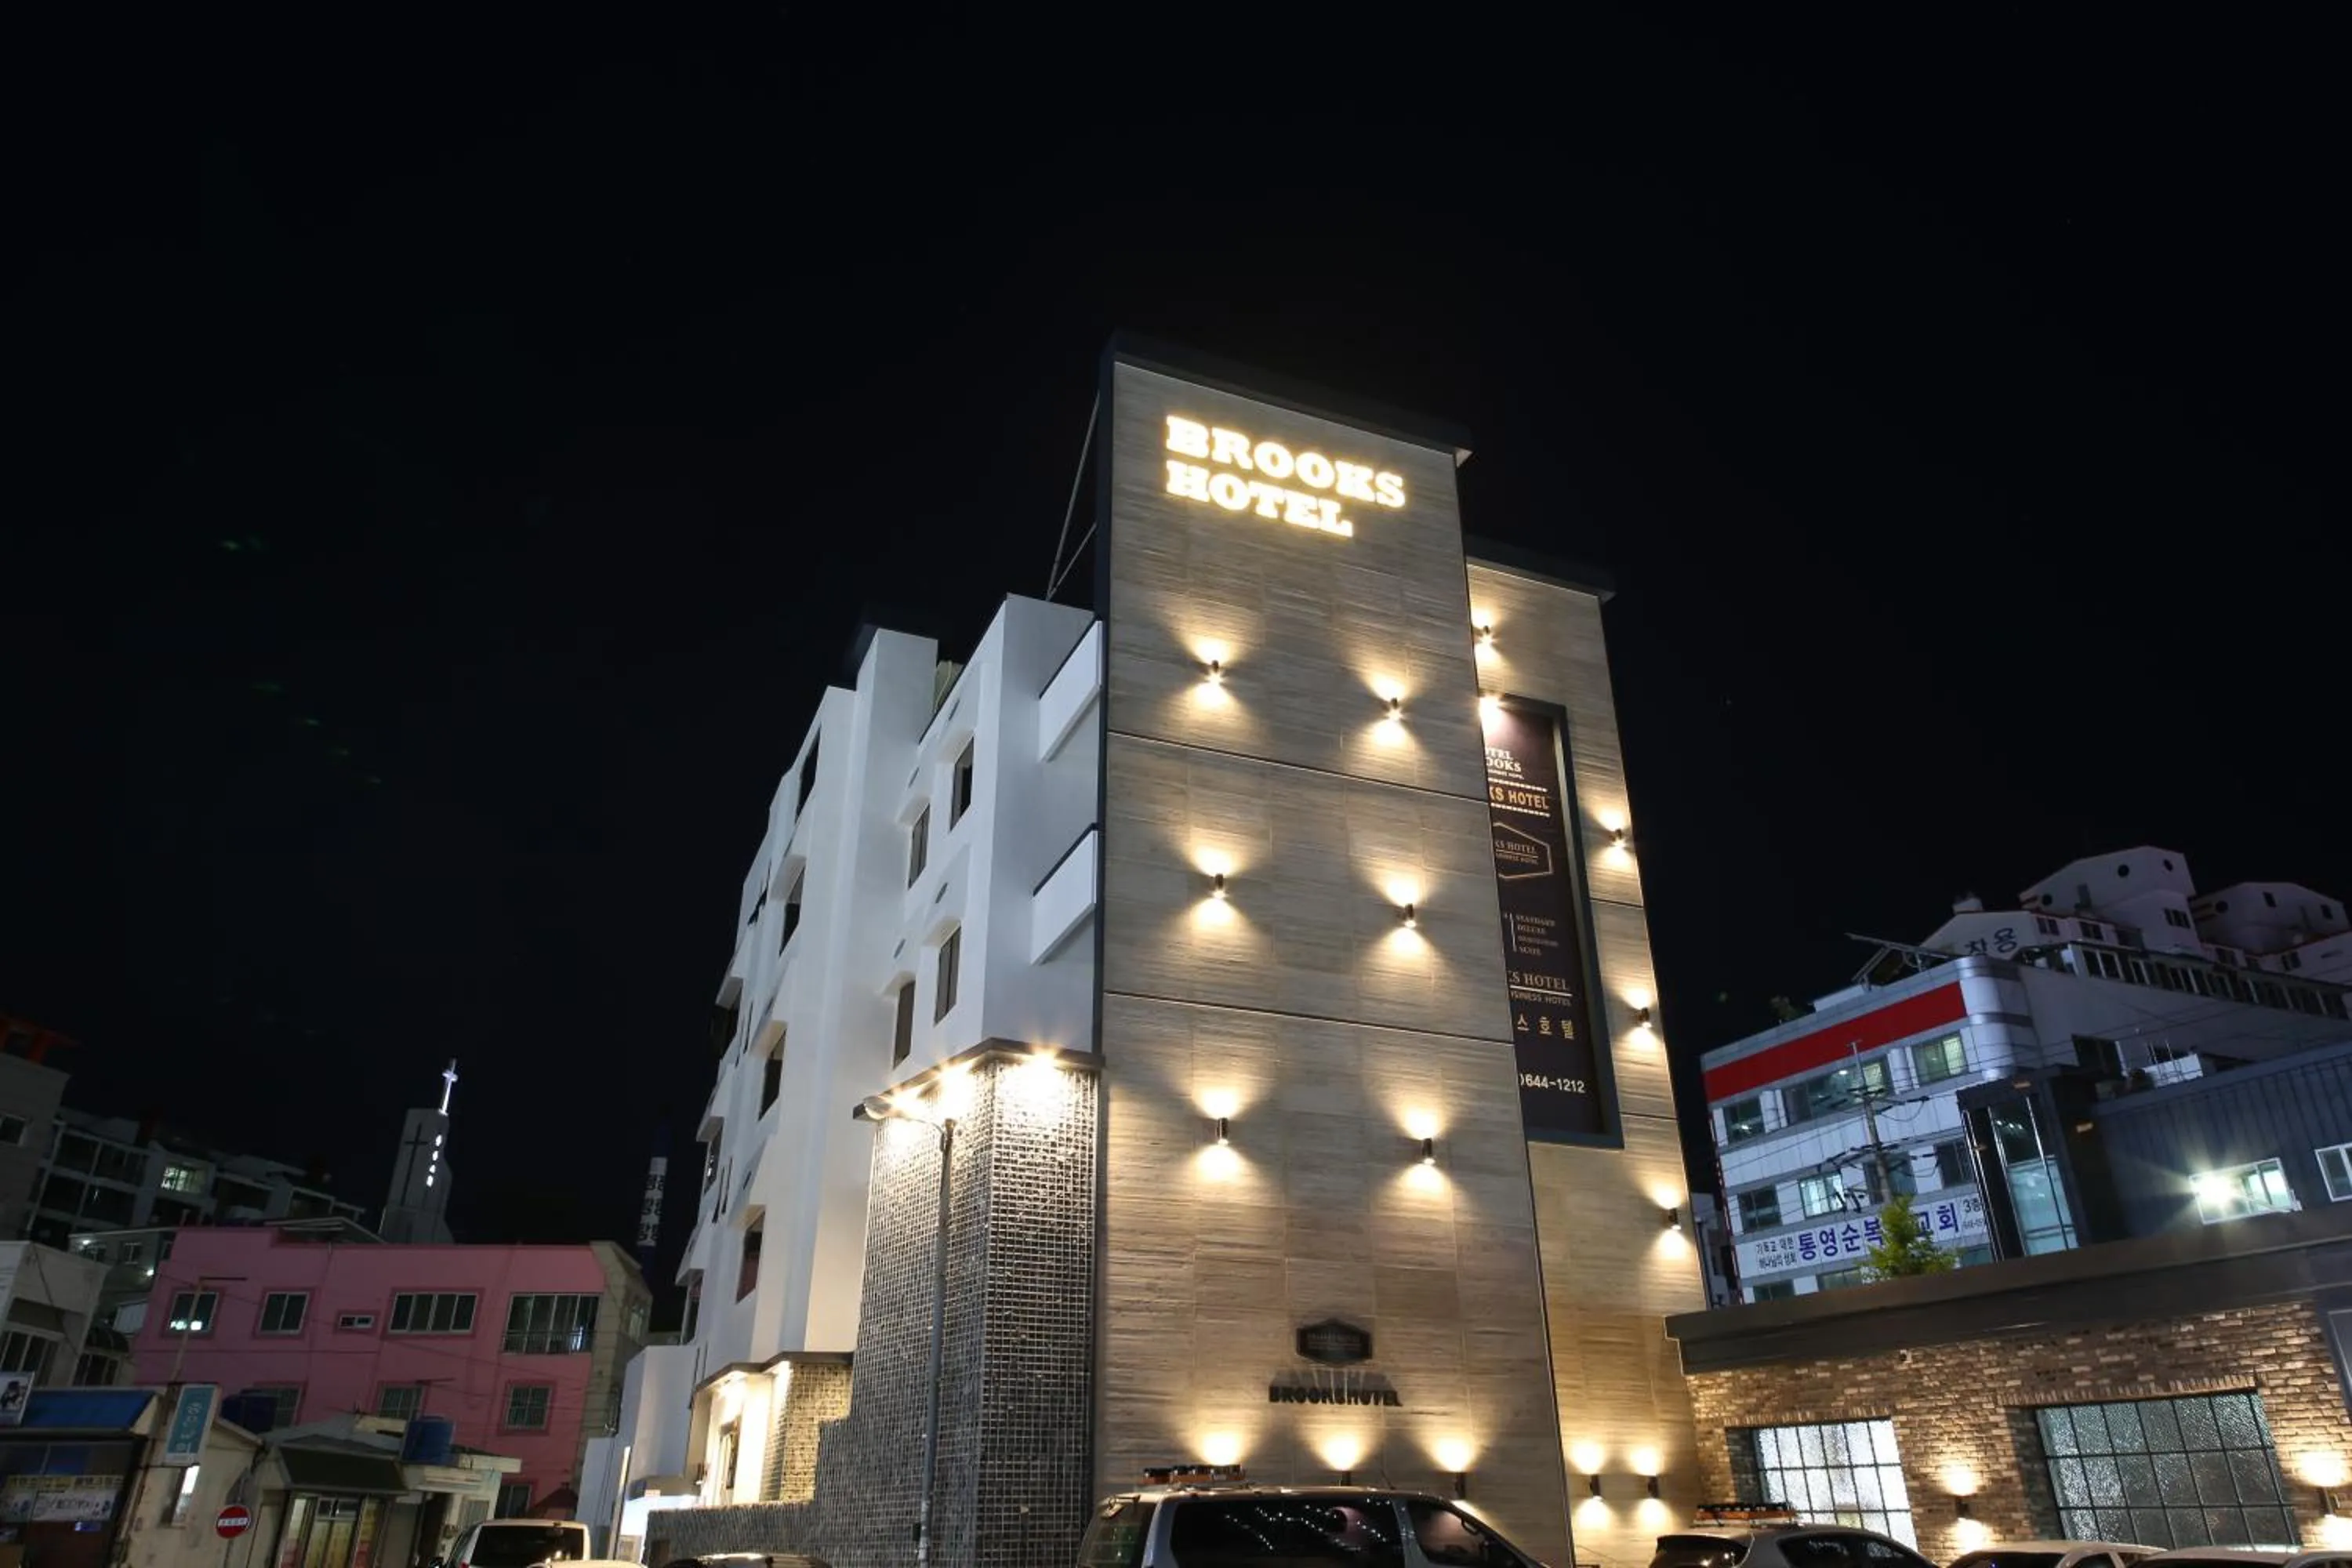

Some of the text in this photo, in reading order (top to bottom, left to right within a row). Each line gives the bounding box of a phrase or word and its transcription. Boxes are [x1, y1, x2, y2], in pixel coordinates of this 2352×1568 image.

[1164, 415, 1406, 508] BROOKS
[1166, 459, 1353, 537] HOTEL
[1508, 789, 1549, 809] HOTEL
[1523, 973, 1570, 991] HOTEL
